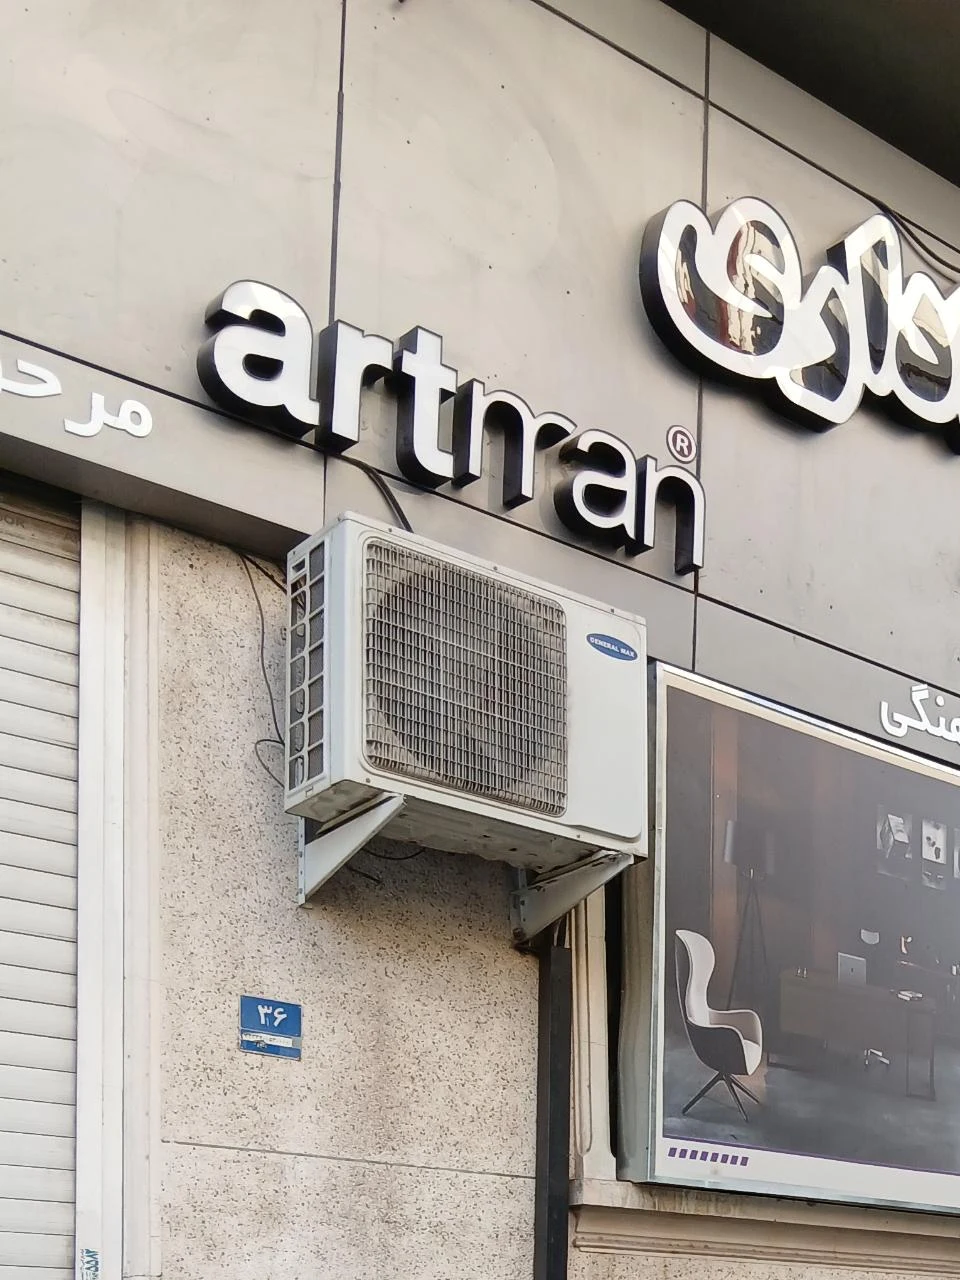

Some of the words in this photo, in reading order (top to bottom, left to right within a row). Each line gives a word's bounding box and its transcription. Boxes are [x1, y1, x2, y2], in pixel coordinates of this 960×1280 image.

[198, 278, 705, 573] artman
[590, 637, 620, 652] GENERAL
[620, 648, 635, 658] MAX
[257, 1004, 288, 1028] ۳۶
